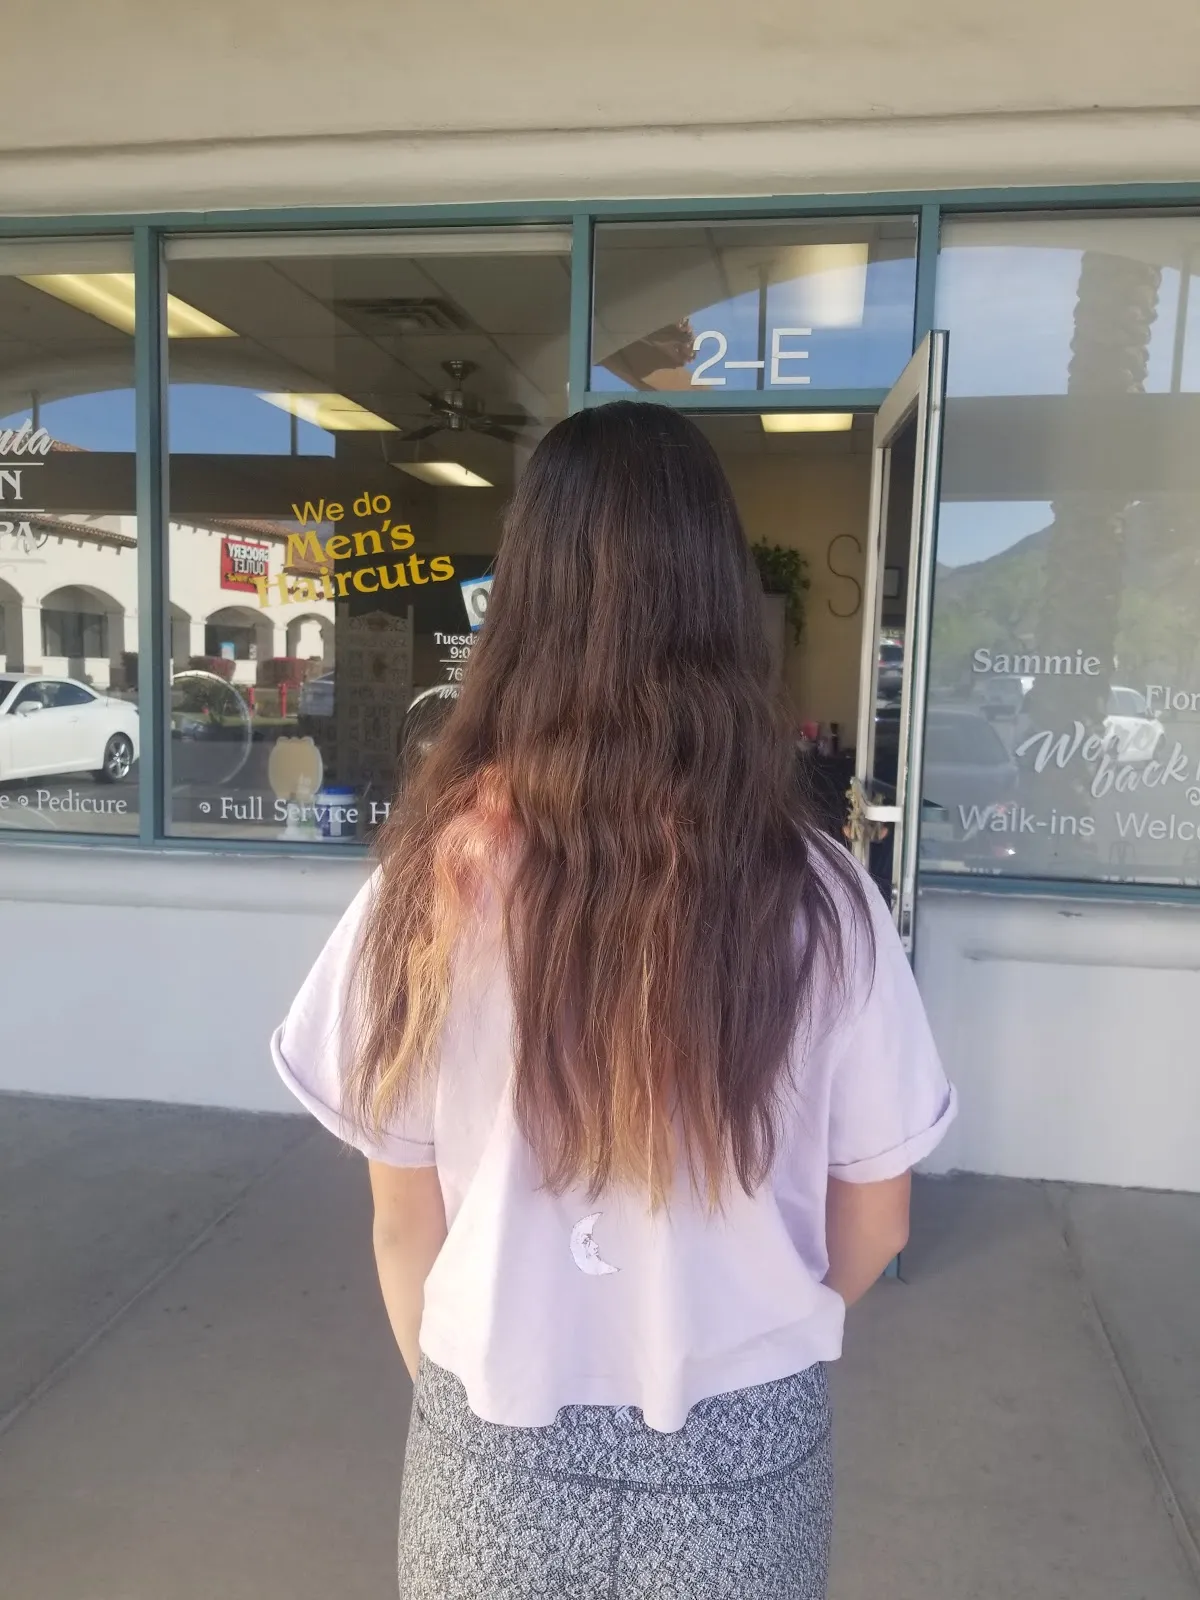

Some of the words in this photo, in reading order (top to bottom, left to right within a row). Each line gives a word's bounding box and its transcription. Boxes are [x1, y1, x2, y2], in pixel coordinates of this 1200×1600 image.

[690, 327, 812, 386] 2-E
[291, 498, 345, 526] We
[353, 491, 392, 518] do
[283, 519, 416, 568] Men's
[254, 552, 455, 609] Haircuts
[972, 648, 1101, 676] Sammie
[1091, 741, 1189, 798] back
[36, 788, 128, 815] Pedicure
[220, 796, 264, 820] Full
[274, 799, 360, 825] Service
[958, 804, 1096, 837] Walk-ins
[1115, 811, 1200, 841] Welc
